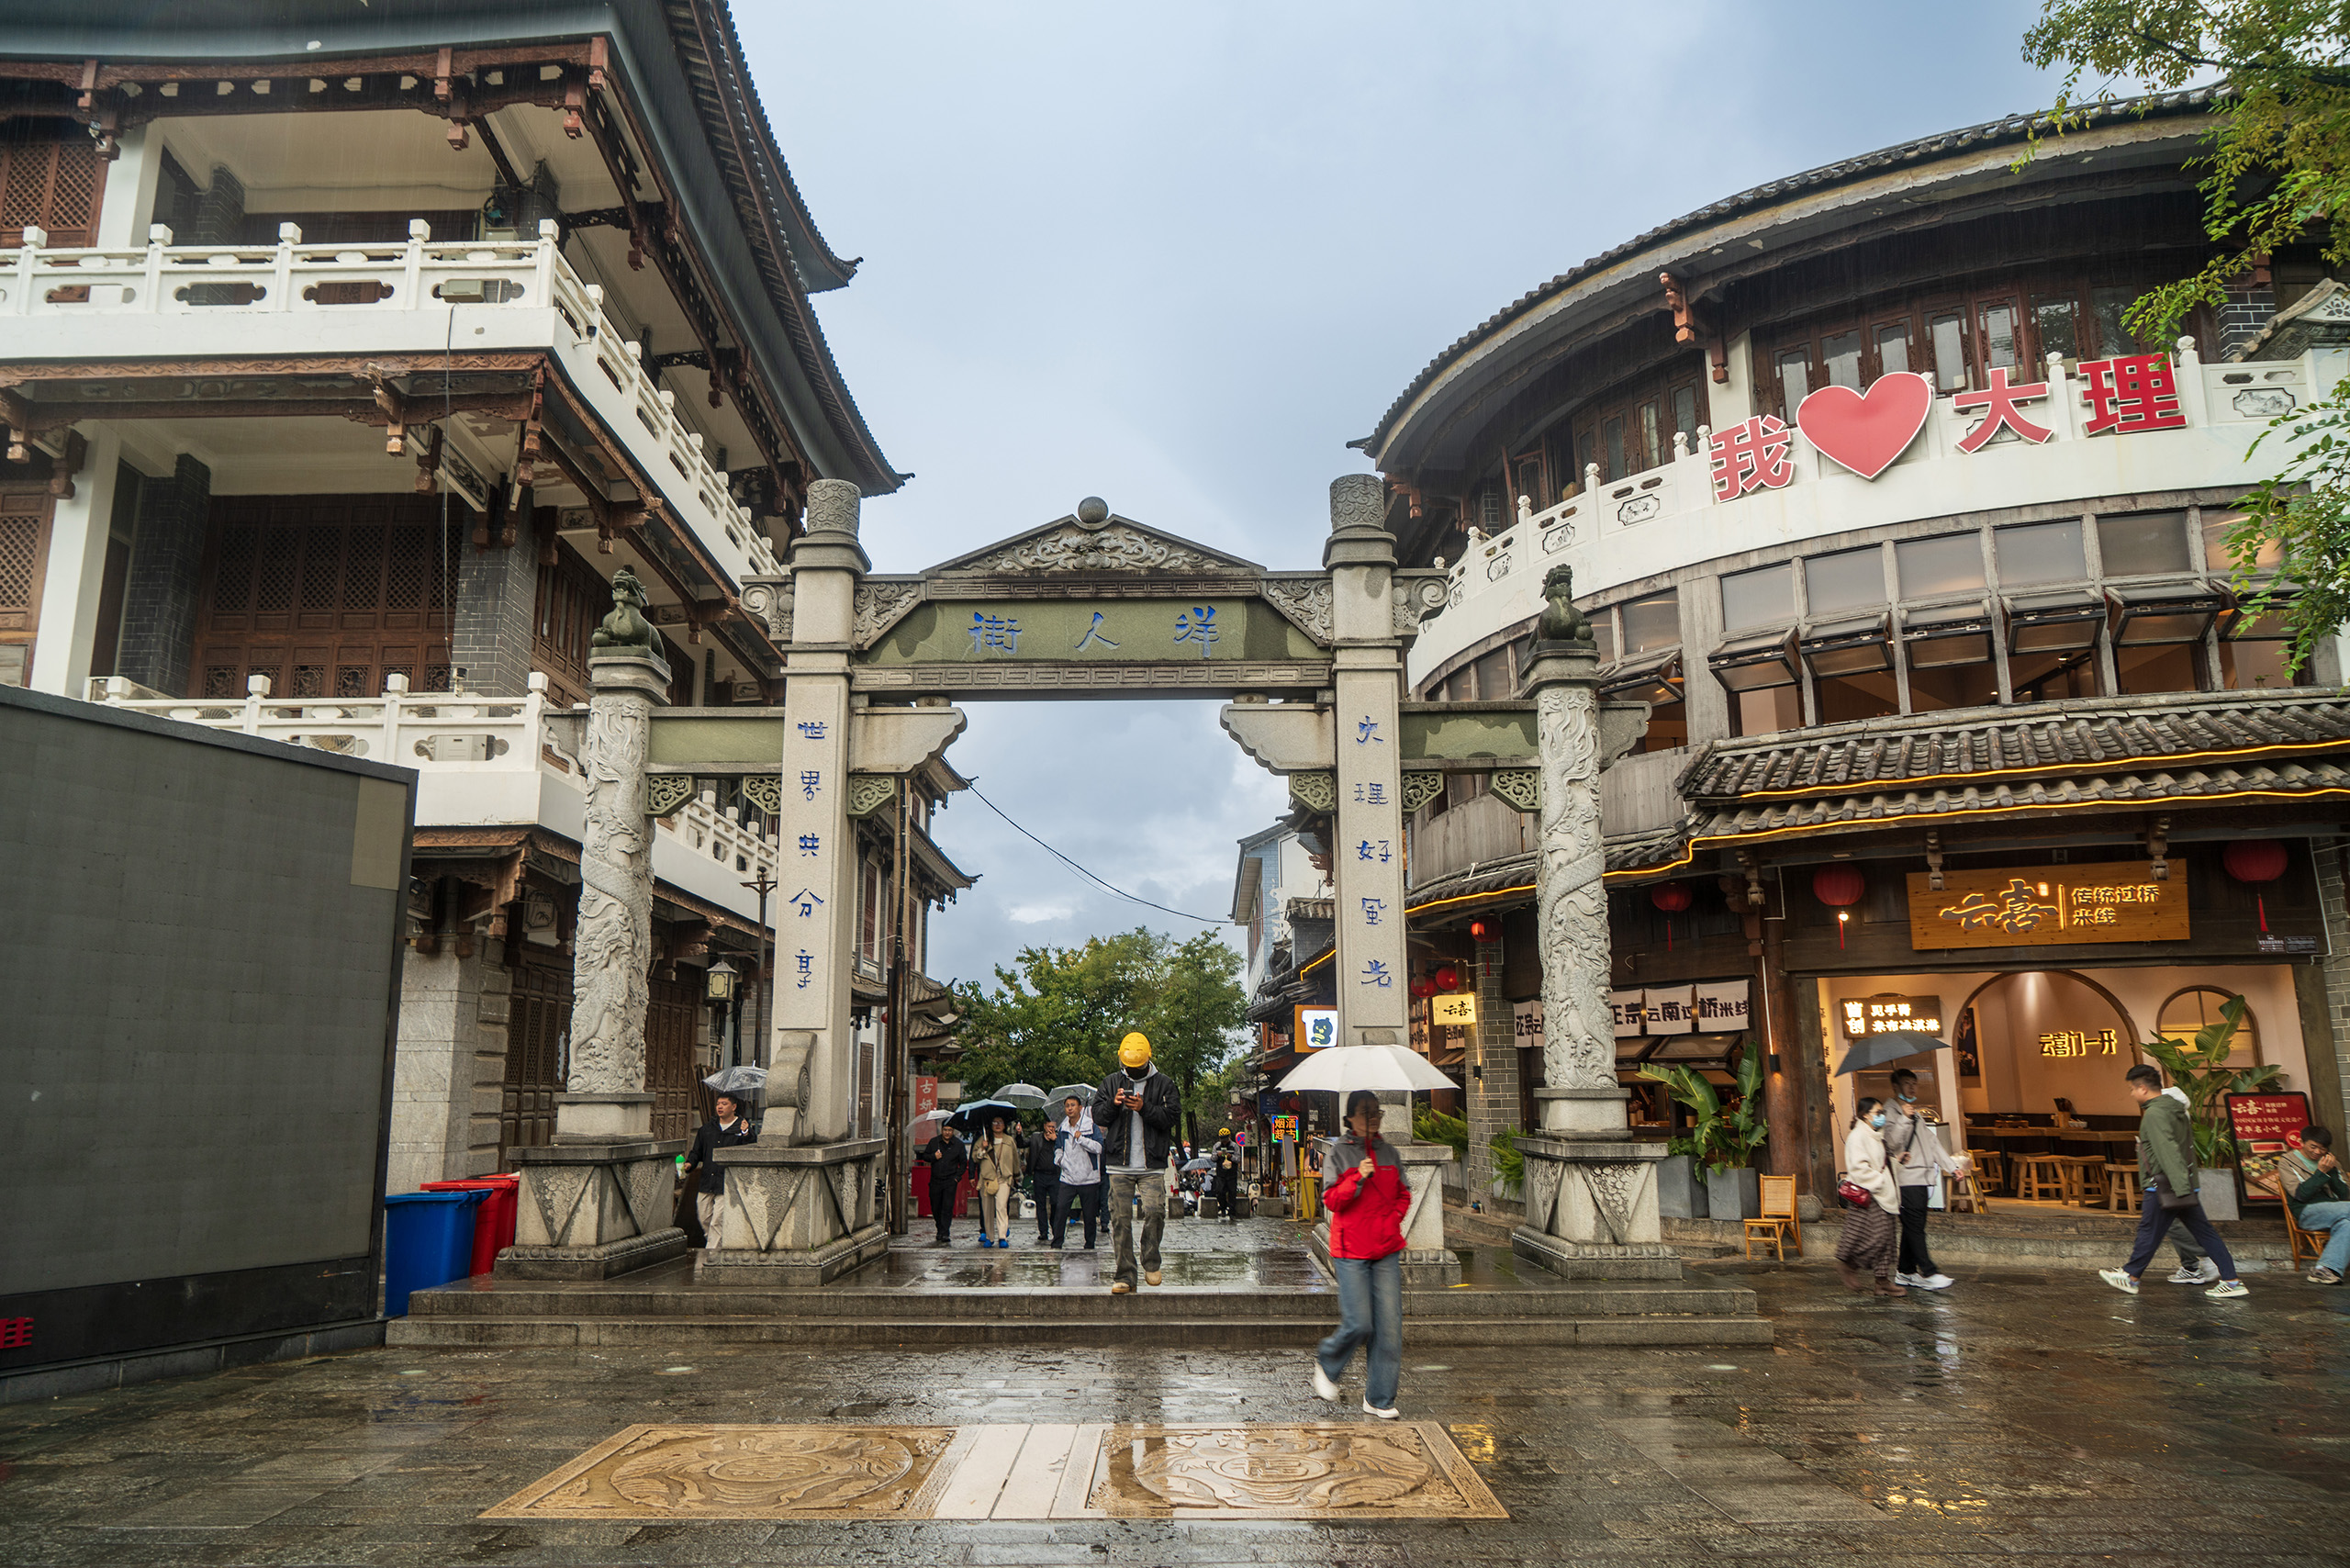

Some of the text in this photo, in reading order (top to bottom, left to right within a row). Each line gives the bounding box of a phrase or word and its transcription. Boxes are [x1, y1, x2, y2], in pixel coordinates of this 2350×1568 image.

[1709, 353, 2188, 502] 我 大理
[2071, 885, 2160, 905] 传统过桥
[1940, 879, 2058, 935] 云喜
[2073, 908, 2117, 926] 米线
[1443, 1001, 1472, 1016] 云喜
[1516, 1013, 1544, 1036] 正宗云
[2038, 1028, 2118, 1058] 云喜门一开
[2231, 1100, 2262, 1114] 云喜
[1274, 1117, 1296, 1128] 烟酒
[2234, 1125, 2282, 1134] 中华名小吃
